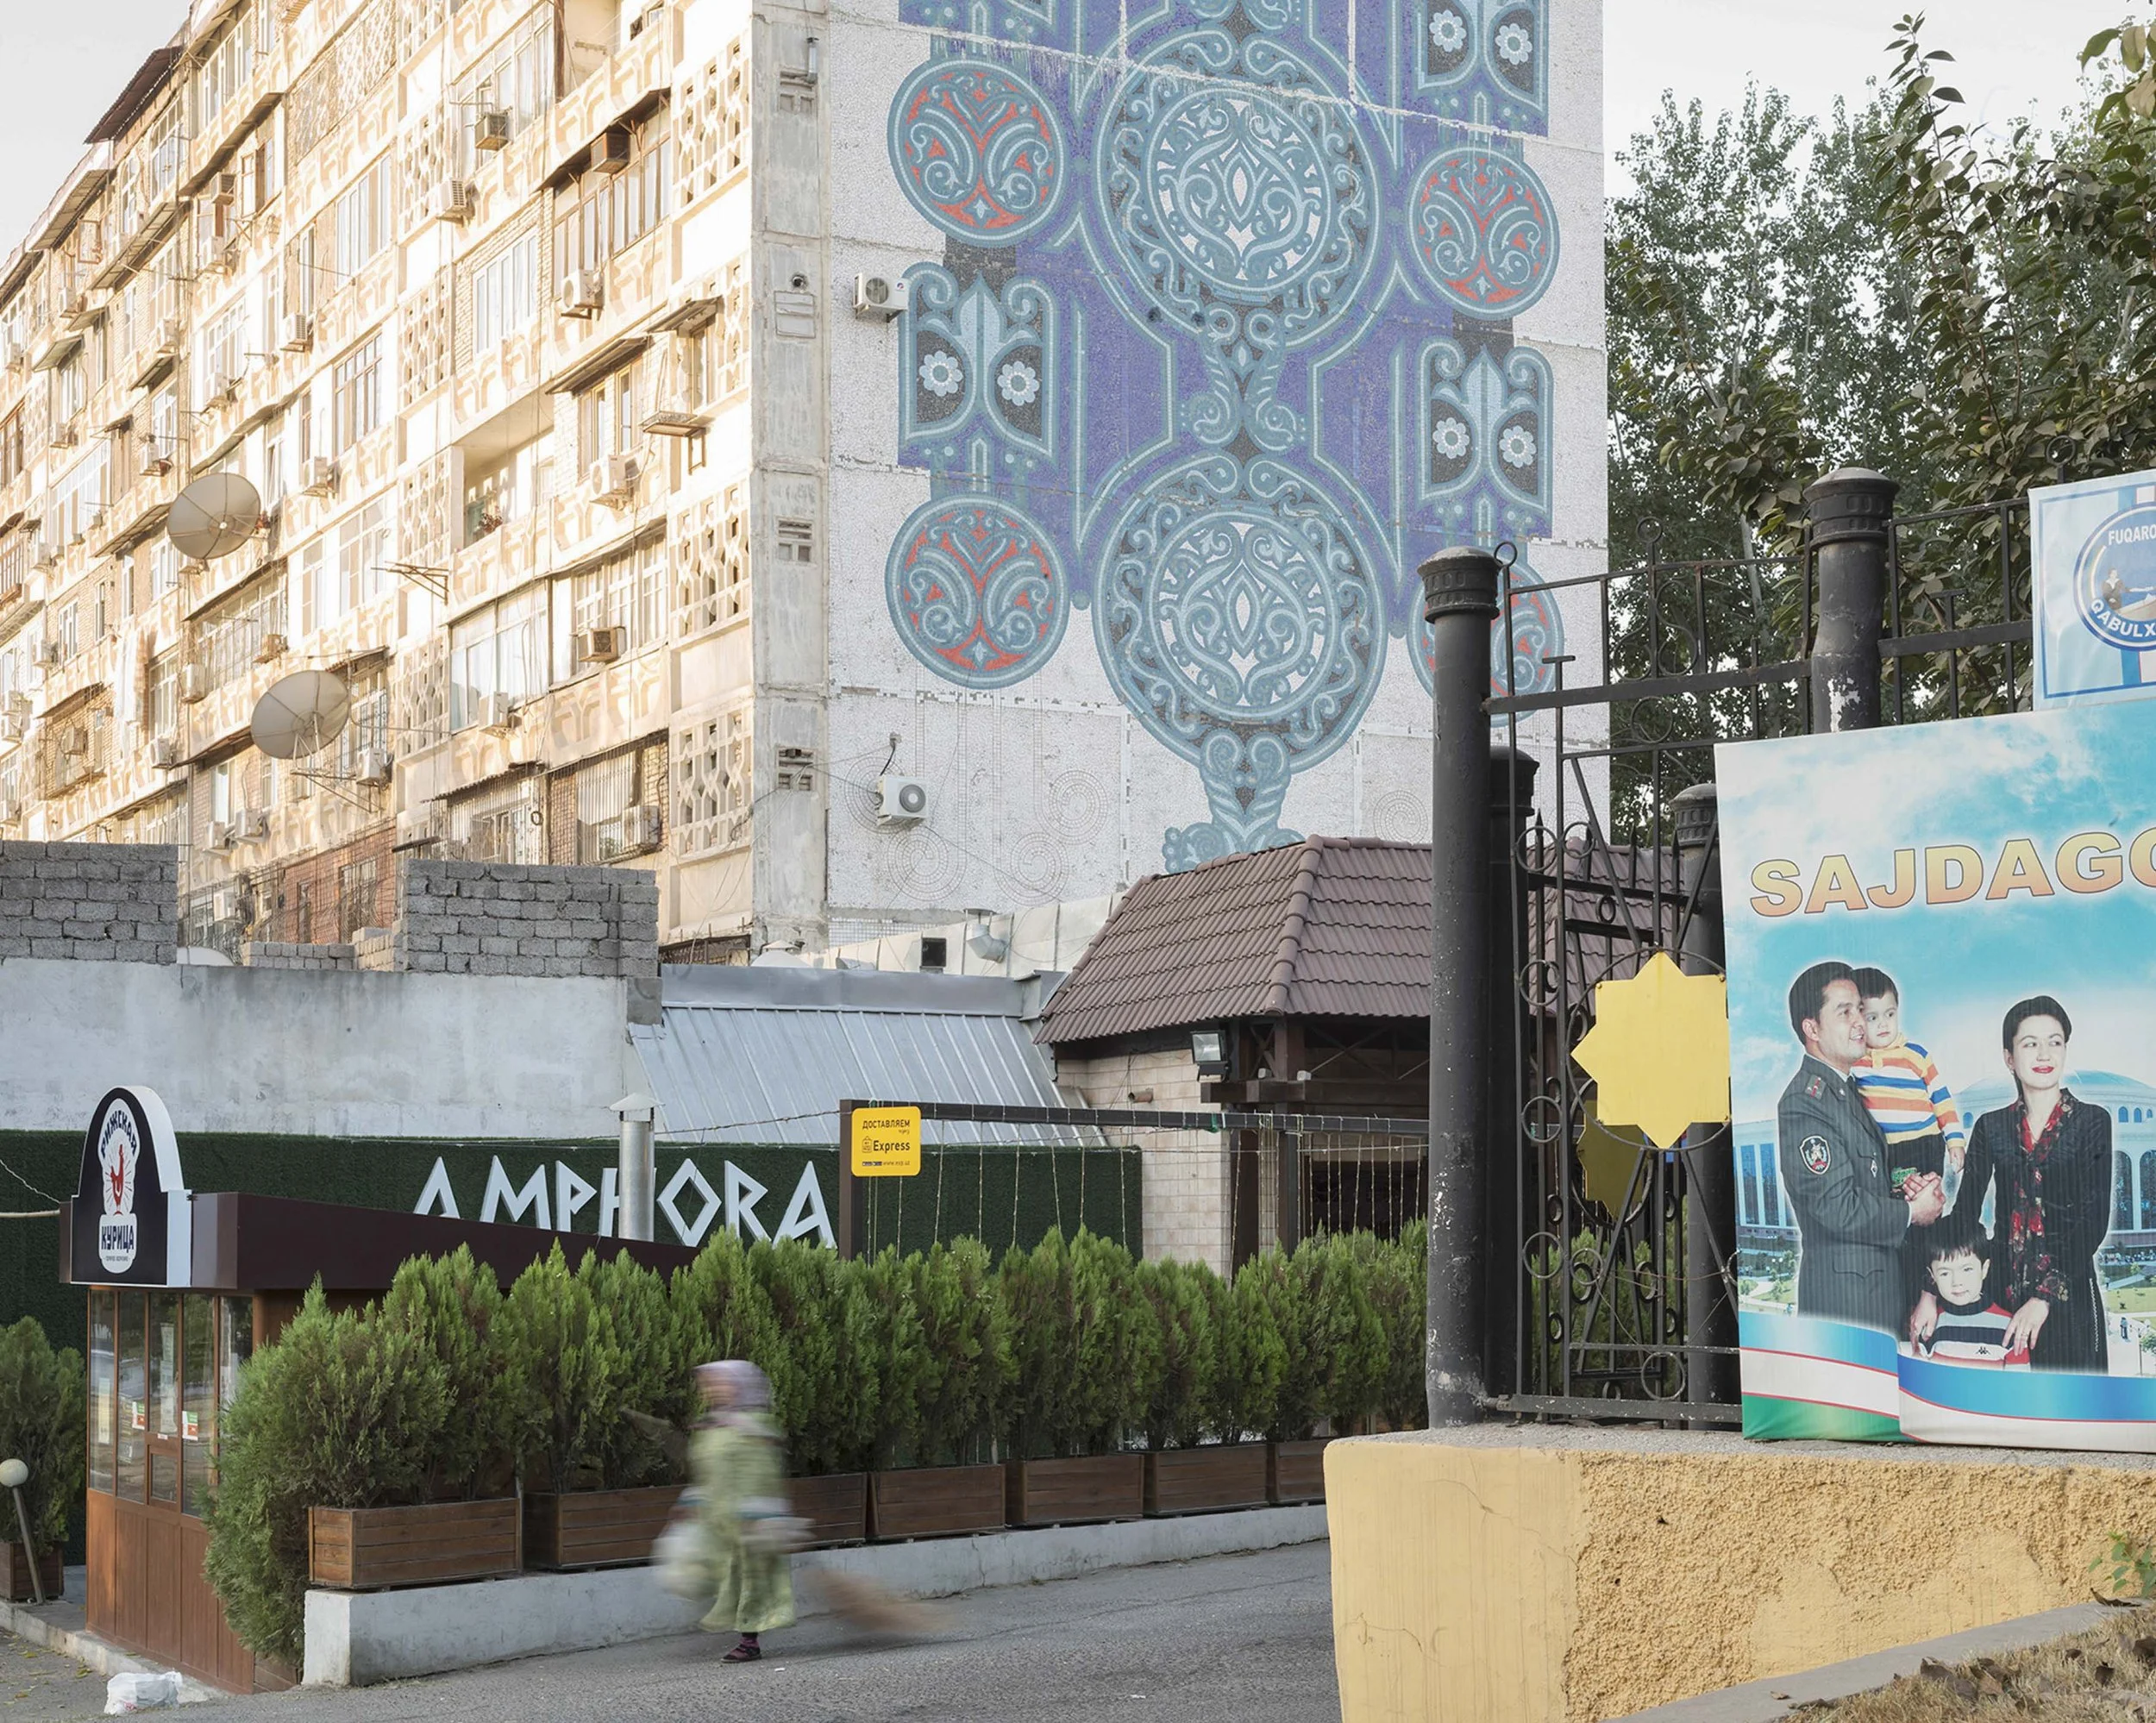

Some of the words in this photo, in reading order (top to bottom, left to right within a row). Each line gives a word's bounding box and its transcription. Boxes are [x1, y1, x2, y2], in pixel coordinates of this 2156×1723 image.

[2109, 524, 2156, 545] FUQARO
[2091, 598, 2156, 637] QABULX
[101, 1110, 137, 1158] РИЖСКАЯ
[862, 1119, 910, 1130] ДОСТАВЛЯЕМ
[874, 1140, 910, 1154] Express
[101, 1225, 135, 1253] КУРИЦА
